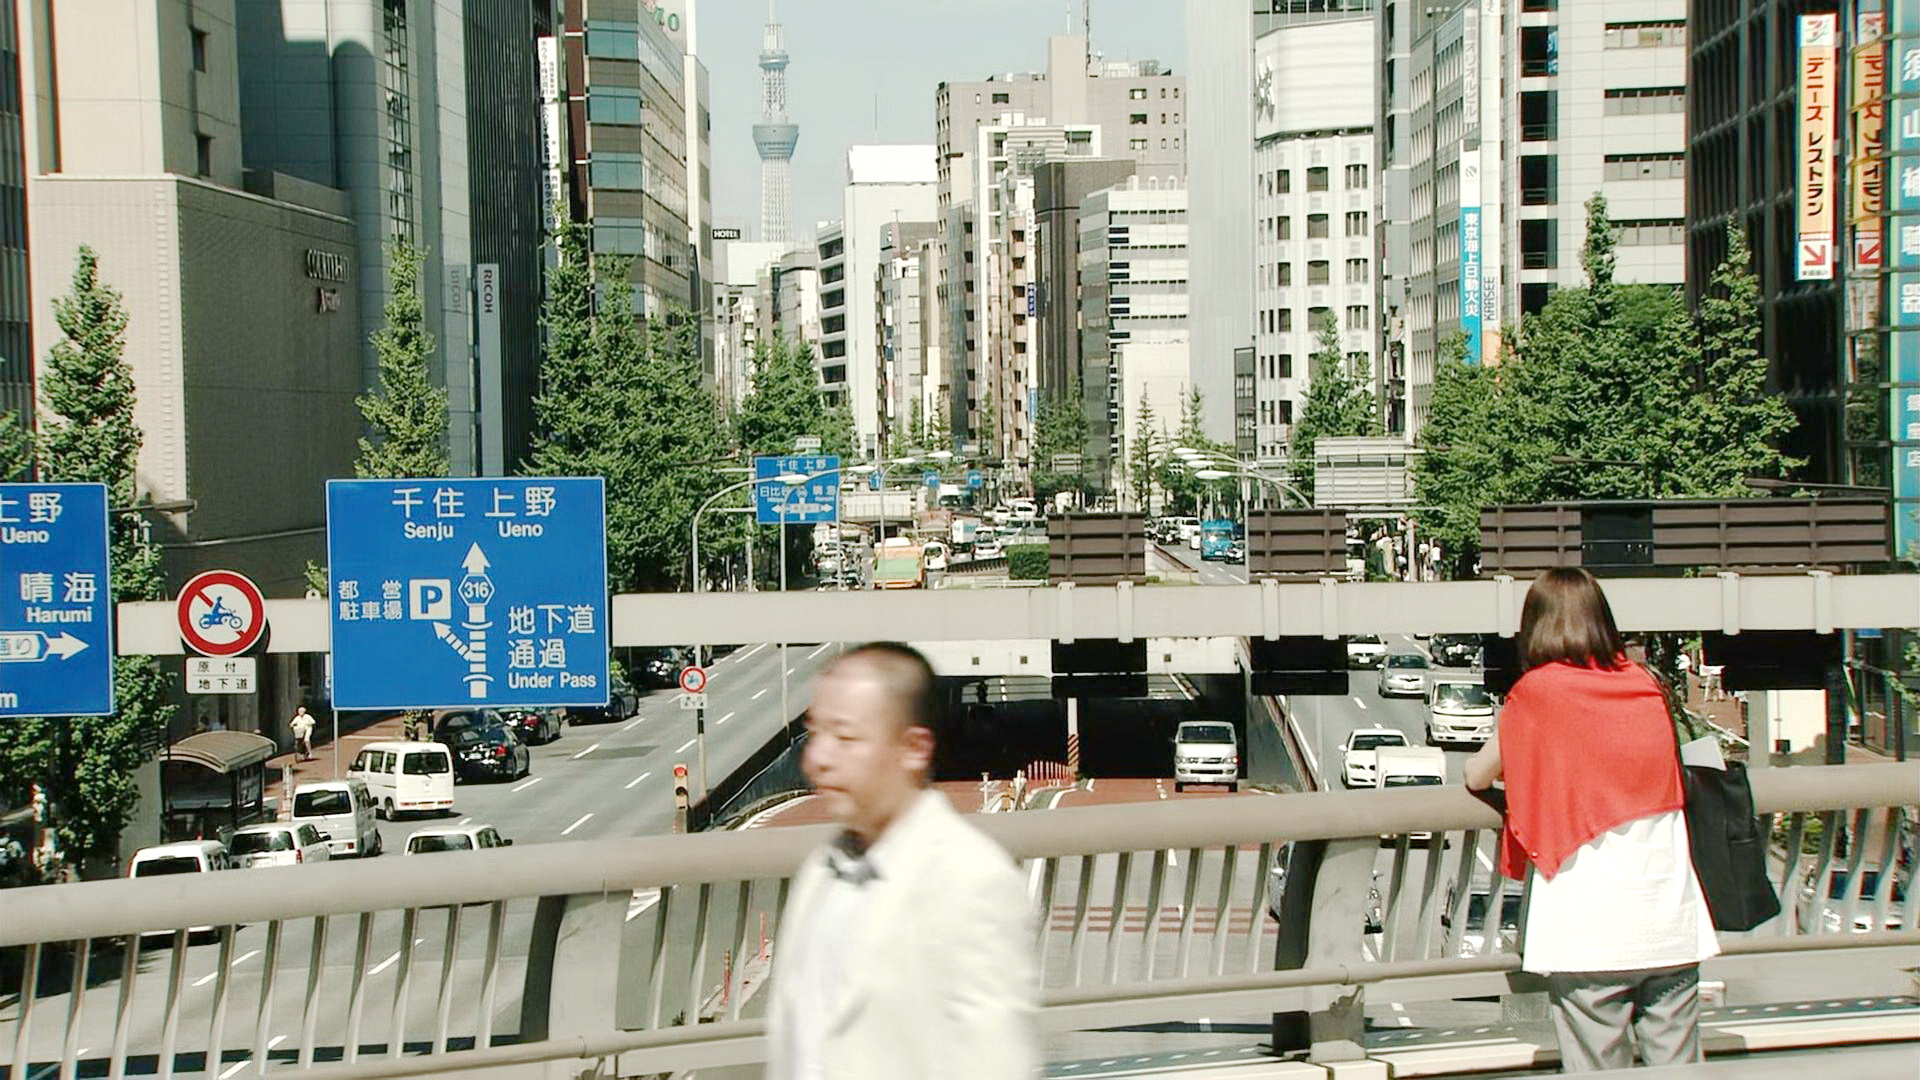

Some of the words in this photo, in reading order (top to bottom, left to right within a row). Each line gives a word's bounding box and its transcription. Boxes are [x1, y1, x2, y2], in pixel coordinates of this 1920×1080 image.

[1806, 57, 1830, 122] デニーズ
[1807, 132, 1823, 217] レストラン
[713, 230, 739, 239] HOTEL
[1464, 213, 1479, 318] 東京海上日動火災
[484, 269, 493, 313] RICOH
[392, 487, 465, 519] 千住
[484, 486, 557, 518] 上野
[1, 526, 50, 544] Ueno
[404, 522, 454, 541] Senju
[498, 521, 543, 538] Ueno
[20, 571, 97, 604] 晴海
[338, 580, 402, 600] 都営
[420, 584, 443, 614] P
[463, 582, 489, 599] 316
[26, 606, 93, 623] Harumi
[339, 600, 402, 621] 駐車場
[507, 603, 595, 635] 地下道
[507, 638, 567, 670] 通過
[199, 678, 248, 690] 地下道
[508, 673, 553, 689] Under
[560, 672, 597, 688] Pass
